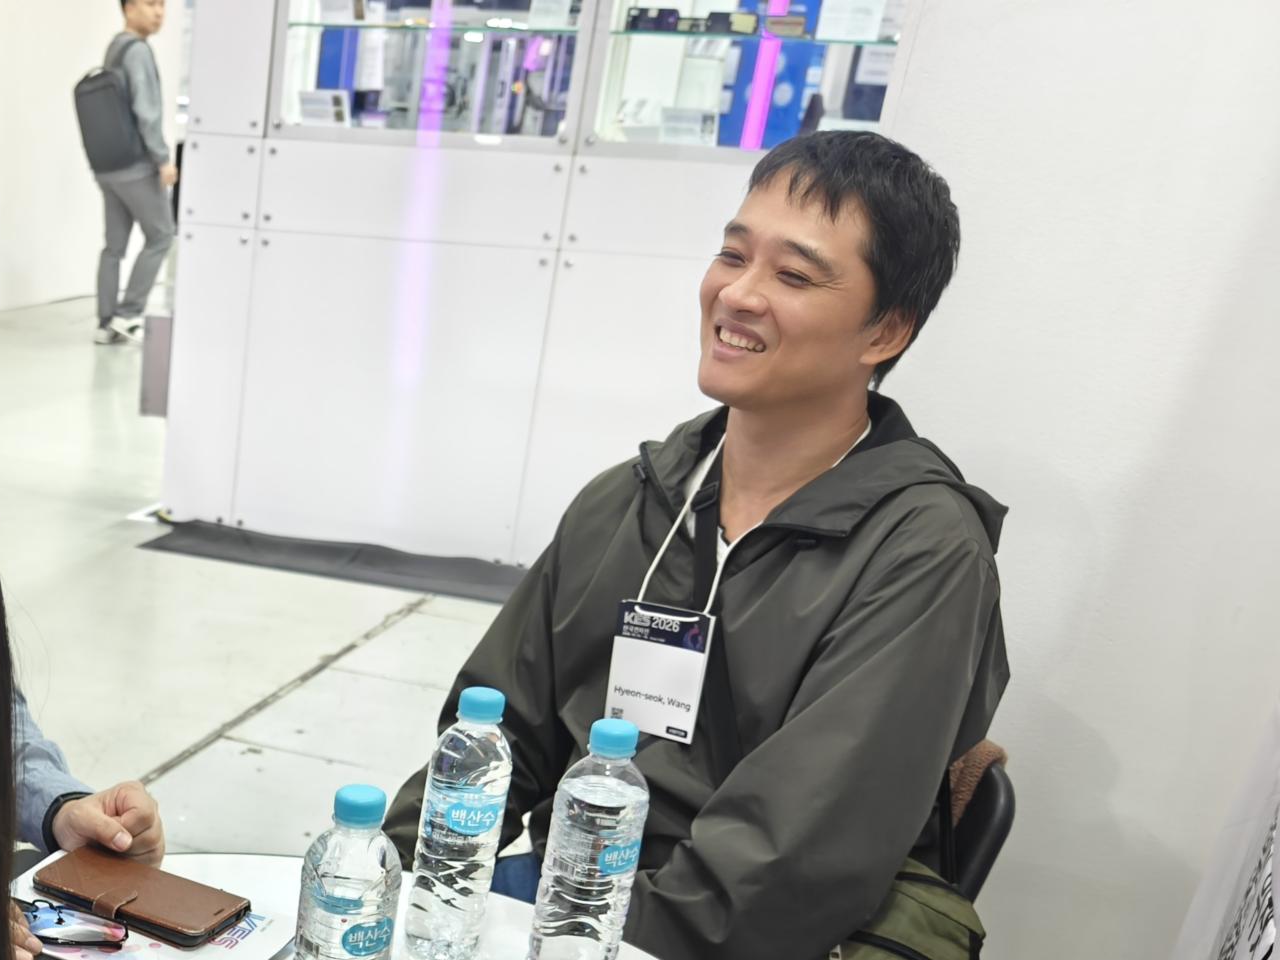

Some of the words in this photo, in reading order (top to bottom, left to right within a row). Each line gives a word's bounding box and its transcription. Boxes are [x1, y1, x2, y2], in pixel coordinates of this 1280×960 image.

[614, 684, 666, 705] Hyeon-seok,
[667, 696, 691, 713] Wang
[451, 808, 496, 827] 백산수
[604, 846, 639, 867] 백산수
[349, 924, 391, 948] 백산수
